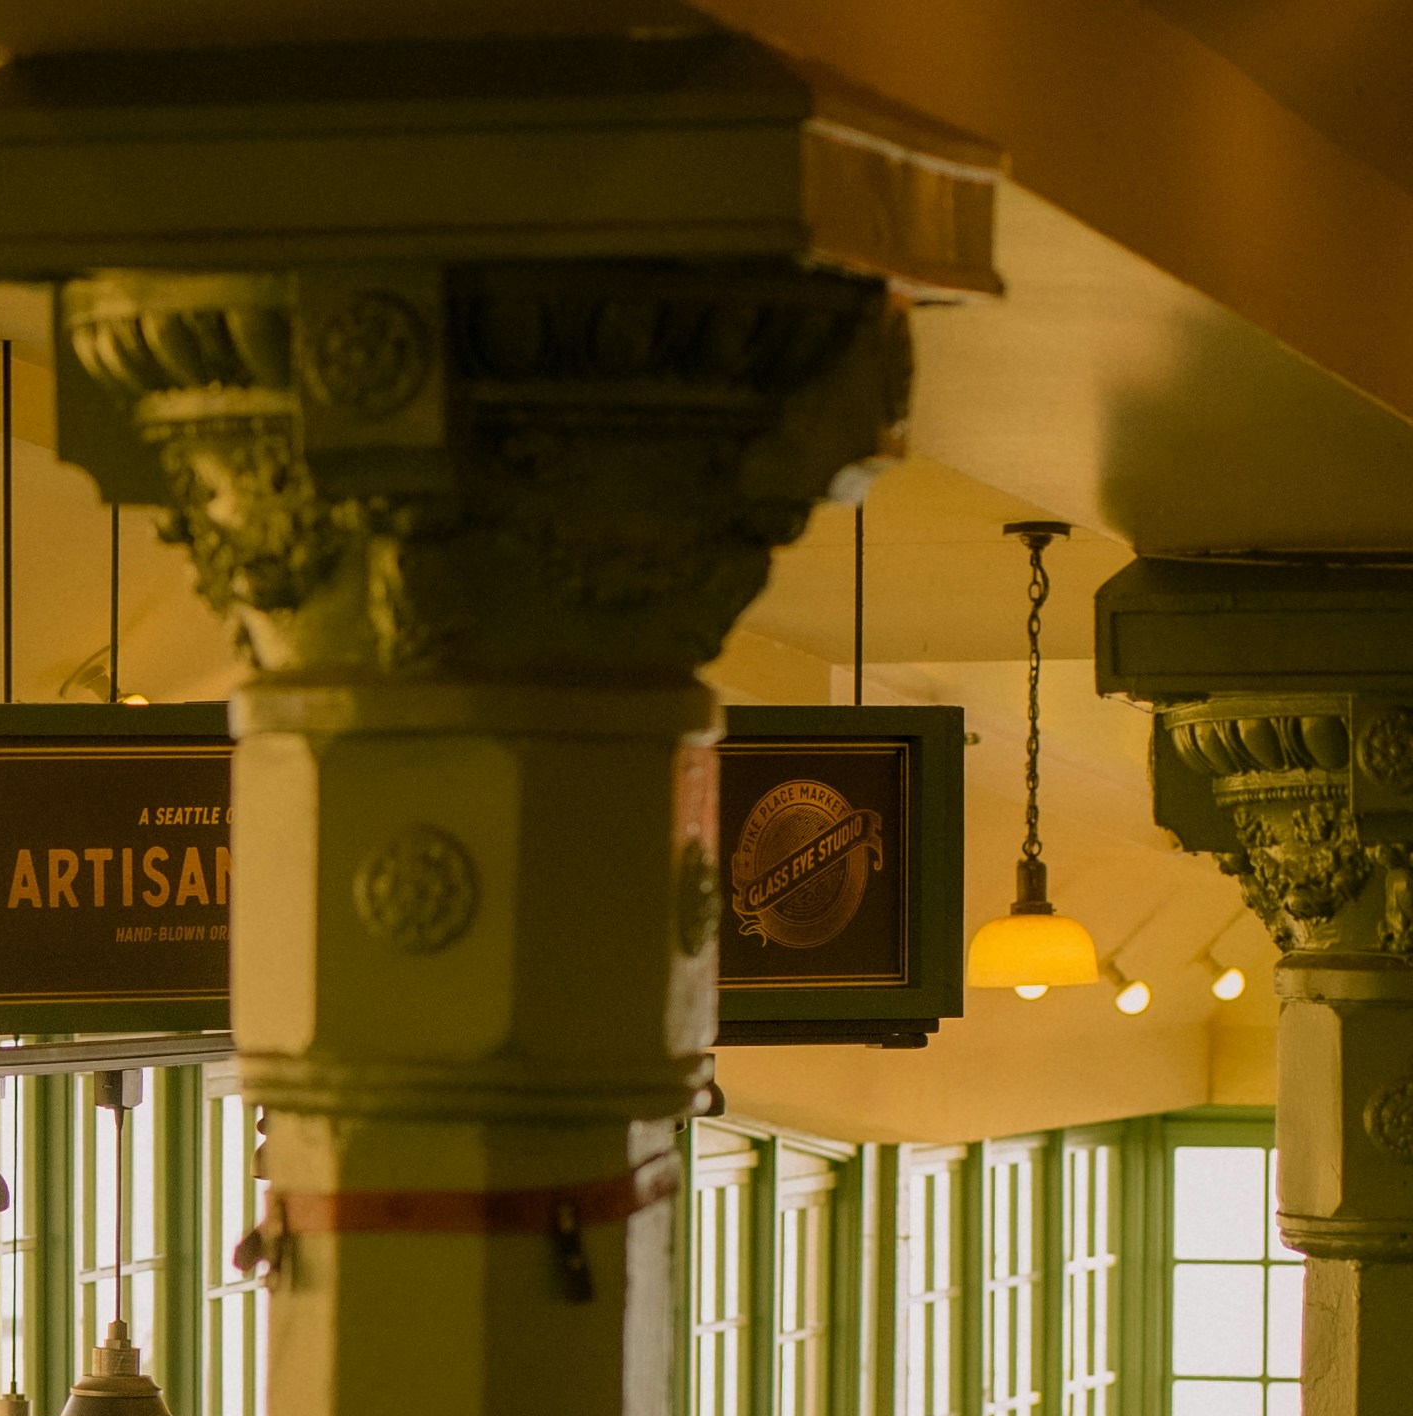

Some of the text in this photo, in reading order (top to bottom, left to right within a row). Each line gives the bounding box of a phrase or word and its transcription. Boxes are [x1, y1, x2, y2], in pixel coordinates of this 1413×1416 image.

[138, 807, 150, 825] A
[154, 806, 220, 825] SEATTLE
[742, 785, 847, 854] PIKE PLACE MARKET
[748, 815, 864, 907] GLASS EYE STUDIO
[115, 925, 205, 943] HAND-BLOWN
